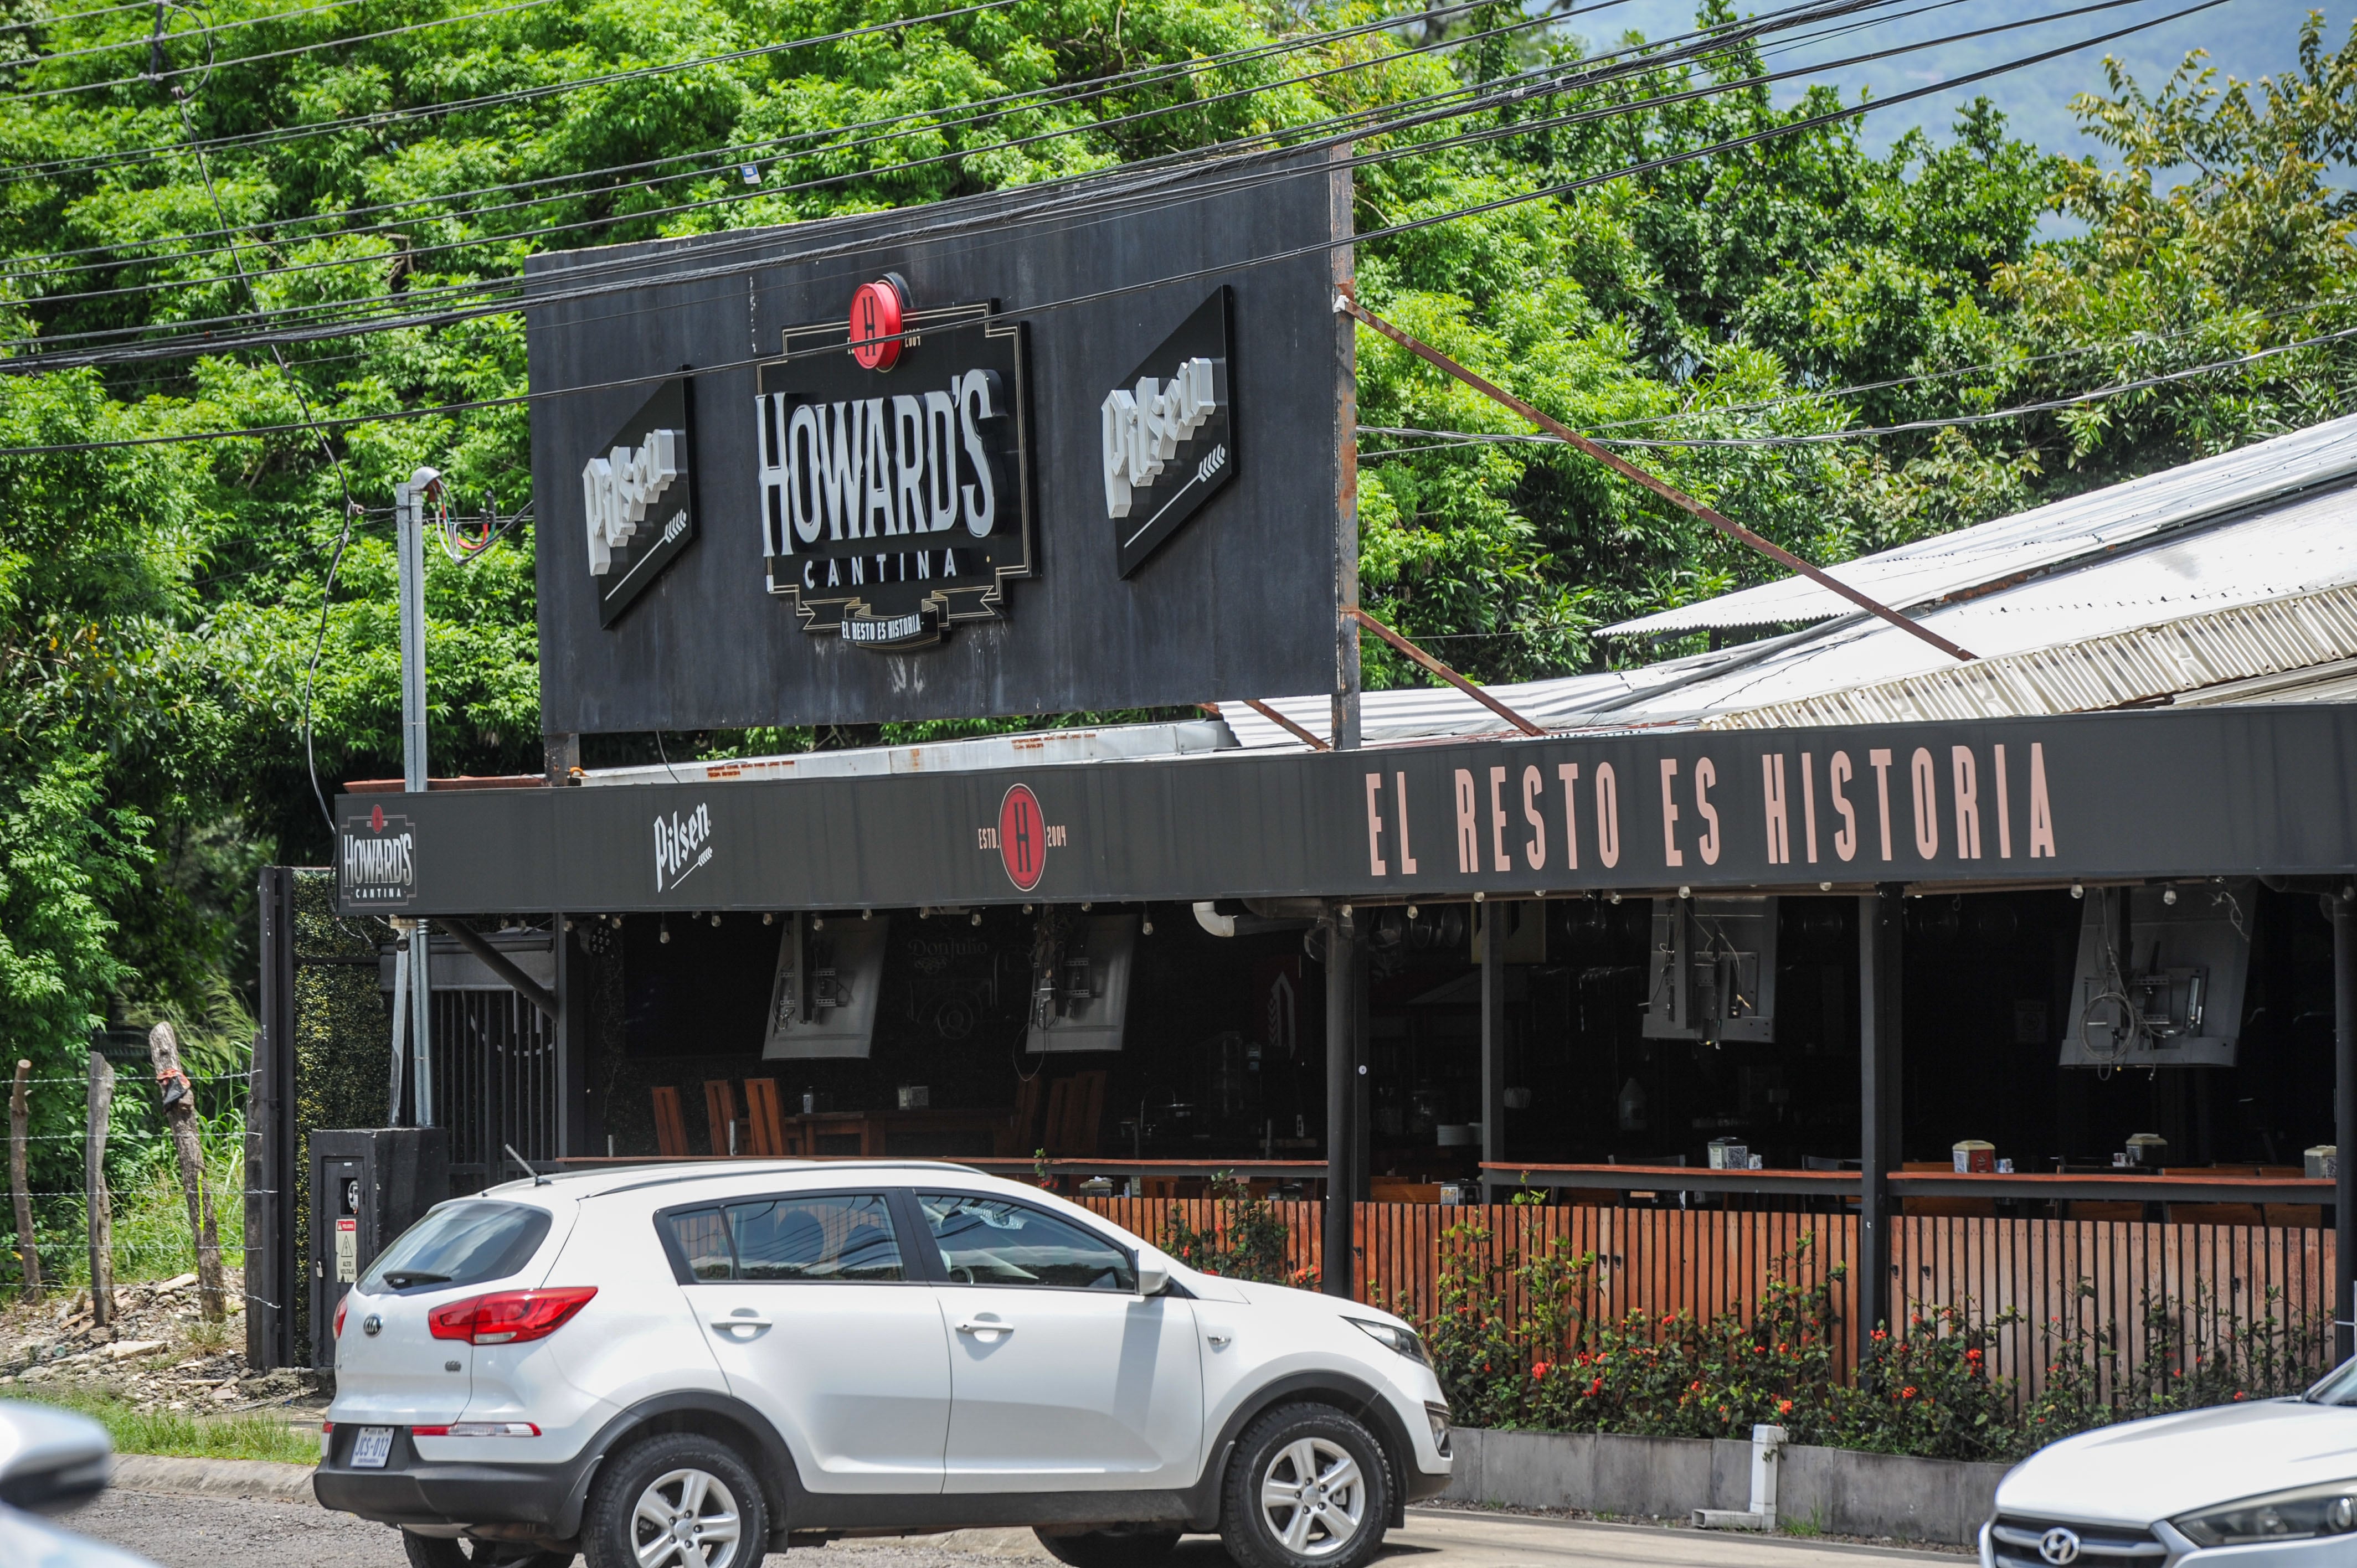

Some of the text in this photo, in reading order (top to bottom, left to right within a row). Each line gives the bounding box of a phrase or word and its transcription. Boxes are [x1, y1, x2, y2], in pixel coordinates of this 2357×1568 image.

[862, 296, 877, 357] H
[755, 368, 998, 557] HOWARD'S
[1101, 357, 1217, 519] Pilsen
[582, 429, 677, 576] Pilsen
[804, 548, 957, 589] CANTINA
[841, 613, 922, 640] EL RESTO ES HISTORIA
[978, 802, 1067, 873] ESTD. H 2004
[1366, 742, 2056, 876] EL RESTO ES HISTORIA
[343, 833, 413, 887] HOWARD'S
[653, 802, 711, 893] Pilsen
[356, 888, 402, 899] CANTINA
